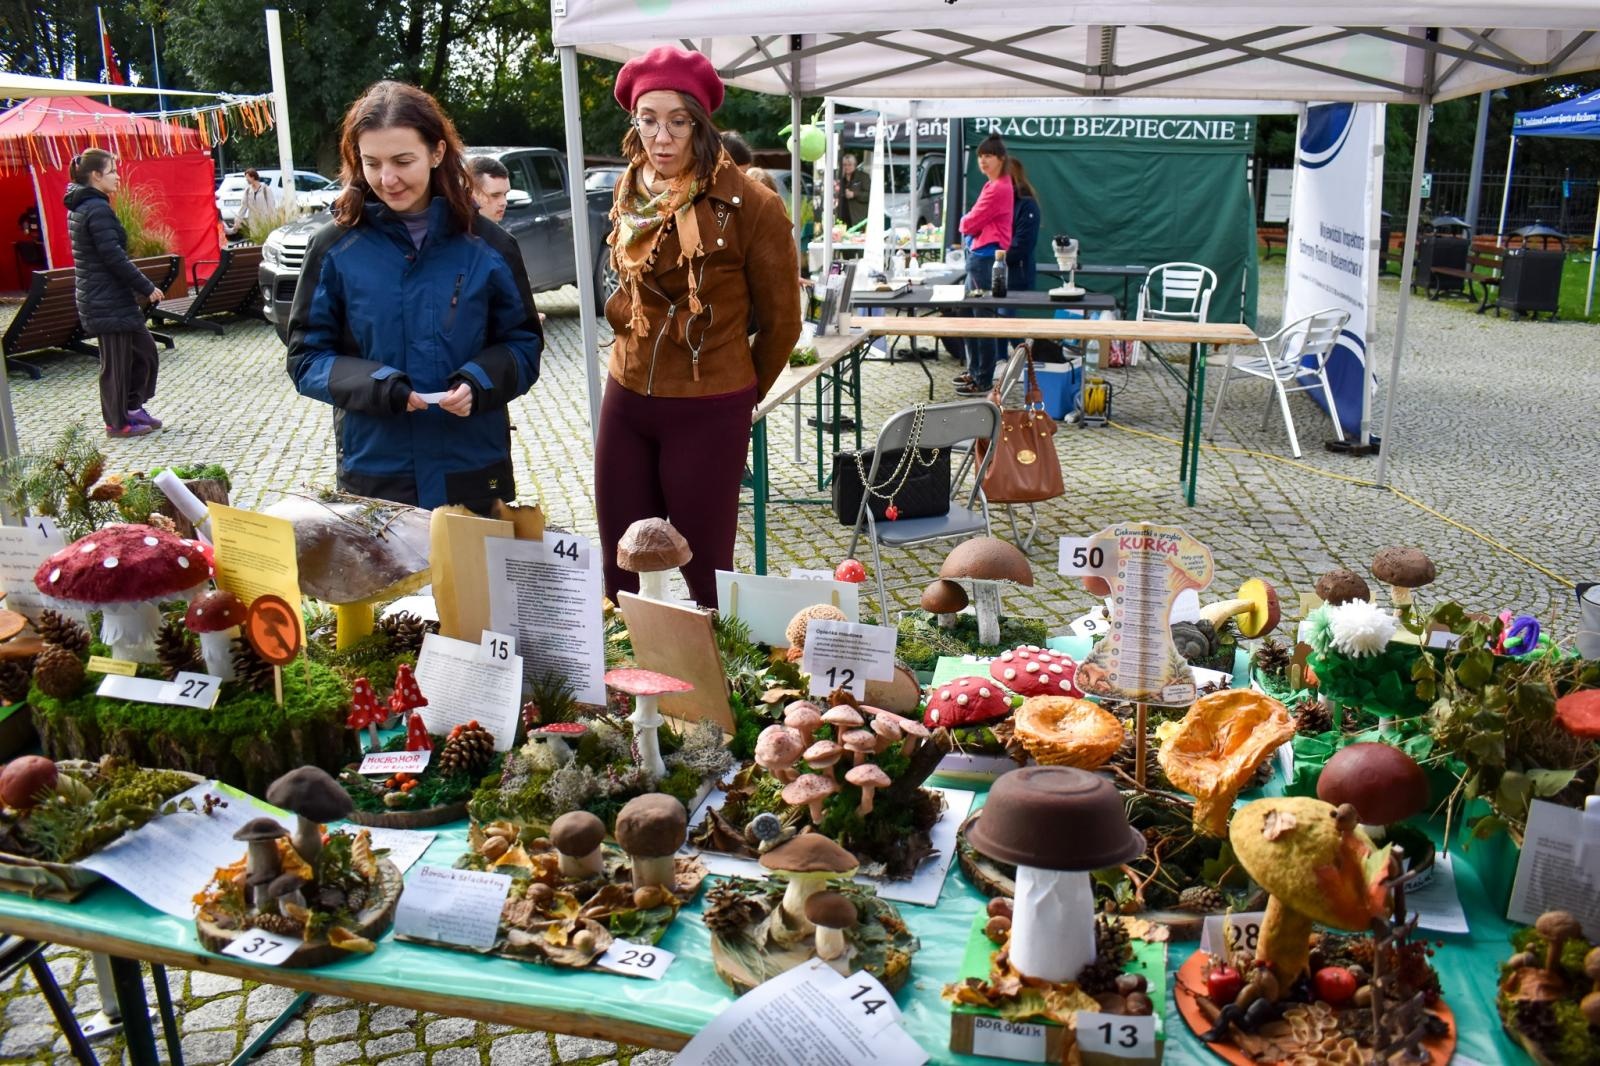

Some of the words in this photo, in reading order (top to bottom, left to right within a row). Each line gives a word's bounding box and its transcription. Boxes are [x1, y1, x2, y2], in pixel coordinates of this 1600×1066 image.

[854, 120, 899, 140] Lay
[975, 117, 1064, 136] PRACUJ
[1073, 117, 1235, 140] BEZPIECZNIE
[38, 522, 48, 538] 1
[1114, 527, 1152, 537] Ciekawostki
[553, 540, 579, 561] 44
[1119, 536, 1179, 556] KURKA
[1072, 547, 1104, 568] 50
[1083, 619, 1096, 631] 9
[490, 638, 508, 660] 15
[179, 679, 209, 698] 27
[825, 666, 855, 691] 12
[243, 937, 283, 957] 37
[1230, 923, 1260, 952] 28
[617, 950, 656, 968] 29
[850, 985, 887, 1015] 14
[976, 1019, 1041, 1037] BOROWIK
[1098, 1022, 1139, 1048] 13
